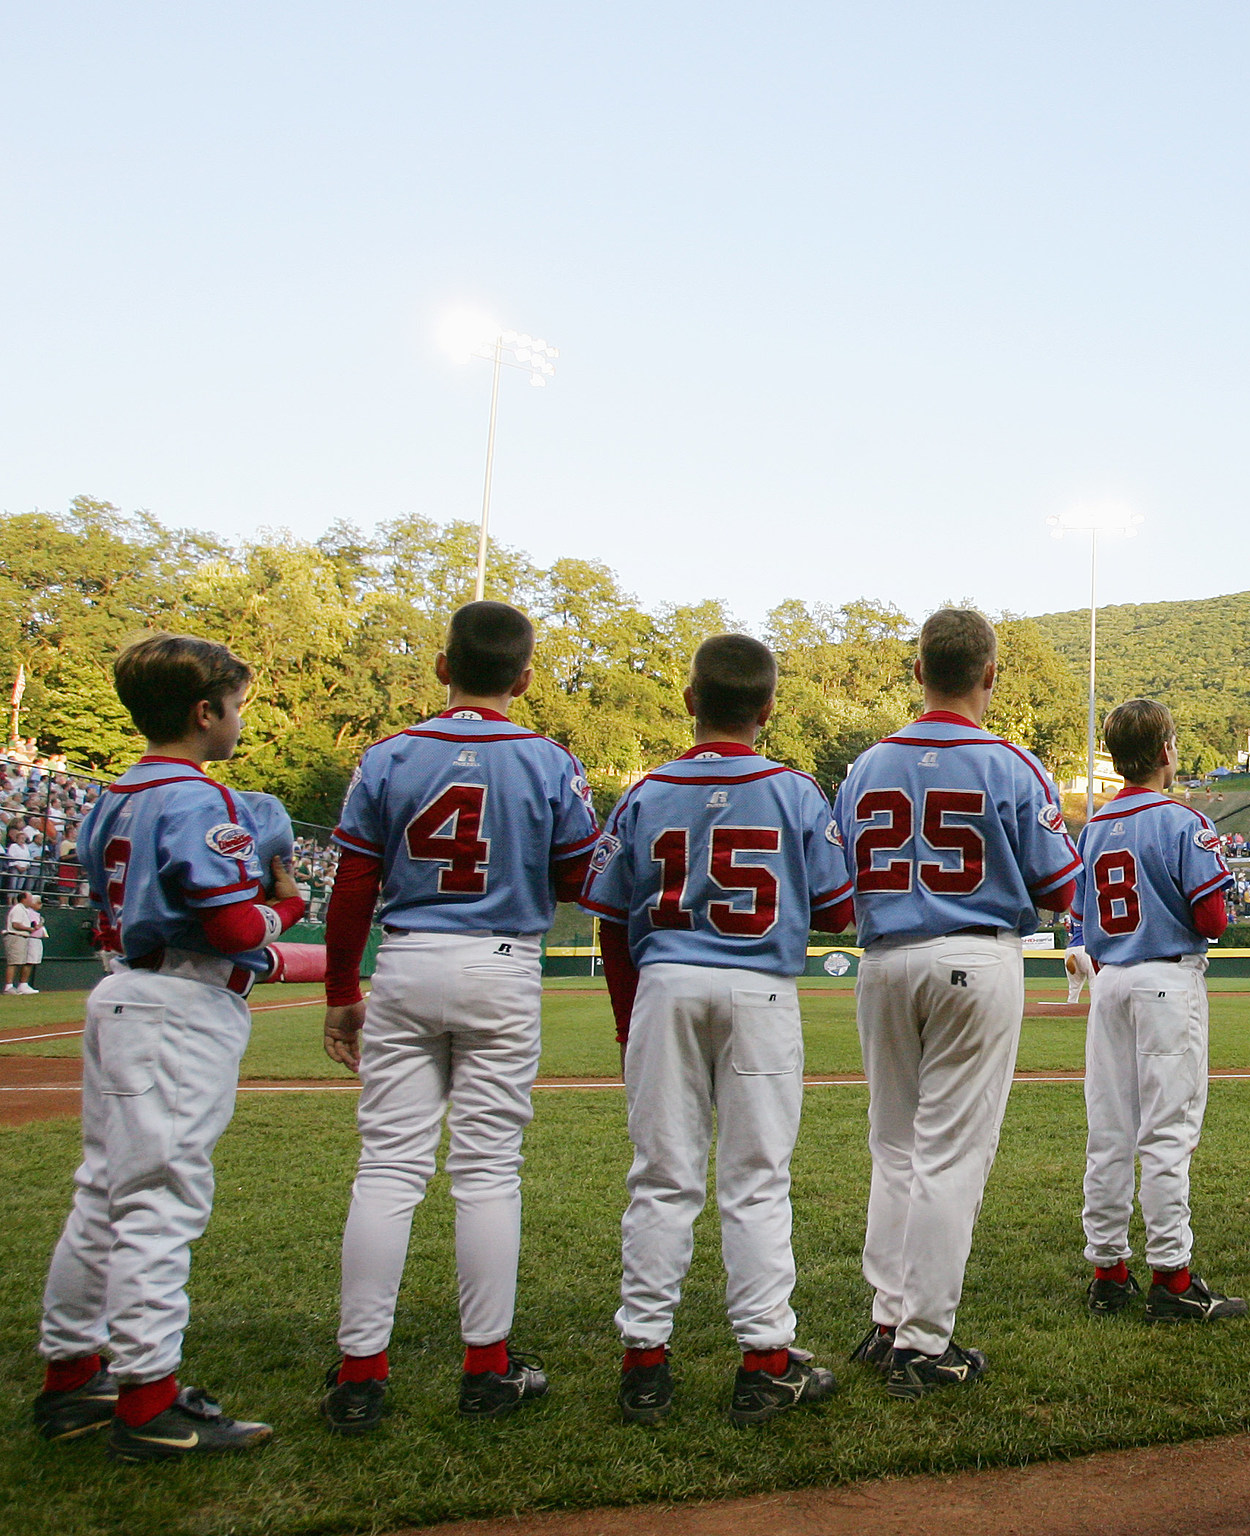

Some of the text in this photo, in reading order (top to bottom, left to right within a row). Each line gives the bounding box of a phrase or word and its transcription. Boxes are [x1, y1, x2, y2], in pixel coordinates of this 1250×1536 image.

[405, 782, 491, 894] 4
[648, 825, 781, 937] 15
[855, 787, 986, 895] 25
[1093, 848, 1142, 937] 8
[951, 969, 968, 987] R
